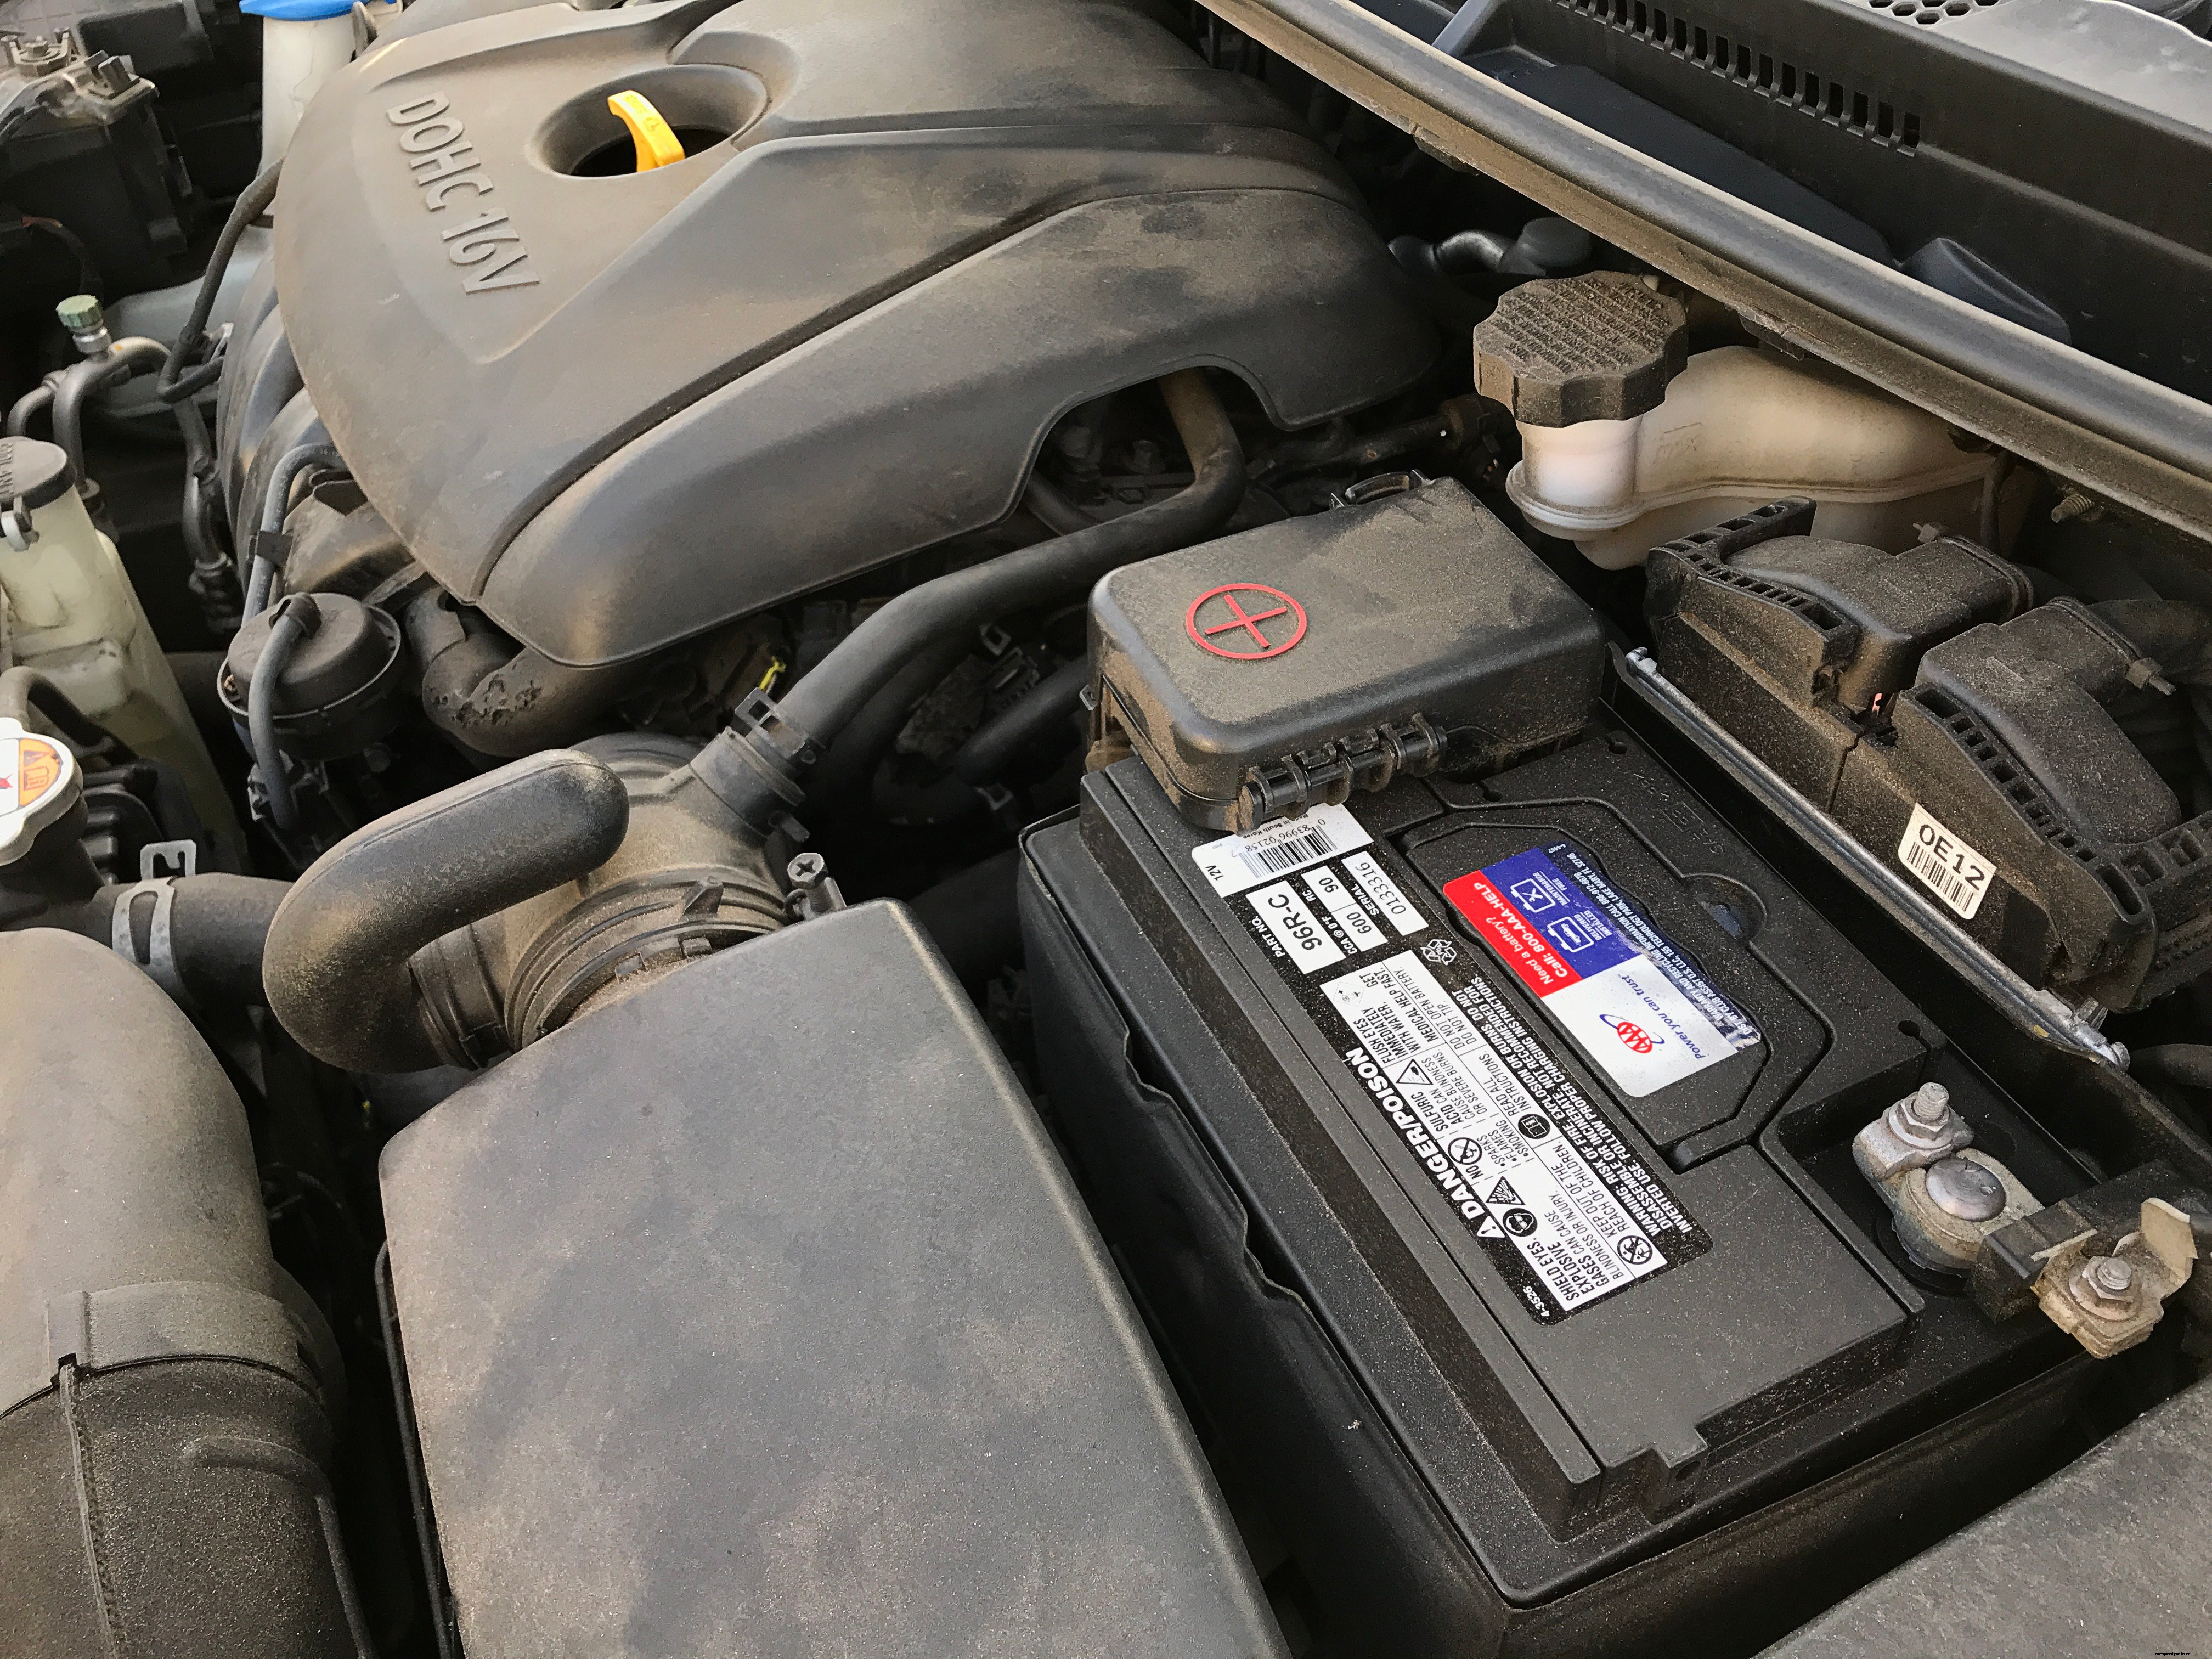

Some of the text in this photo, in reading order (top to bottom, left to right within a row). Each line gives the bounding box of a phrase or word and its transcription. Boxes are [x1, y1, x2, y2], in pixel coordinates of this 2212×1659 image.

[387, 91, 540, 295] DOHC 16V
[1245, 836, 1277, 852] 02158
[1262, 824, 1283, 832] South
[1279, 824, 1310, 840] 83996
[1205, 865, 1224, 881] 12V
[1566, 852, 1585, 868] 32746
[1580, 866, 1592, 874] FL
[1301, 889, 1317, 902] RC
[1317, 876, 1339, 893] 90
[1354, 861, 1407, 915] 0133316
[1532, 871, 1568, 906] MAINTENANCE
[1551, 877, 1567, 891] FREE
[1586, 871, 1607, 889] MARY,
[1601, 887, 1620, 901] LAKE
[1349, 883, 1380, 916] SERIAL
[1605, 902, 1622, 917] CALL
[1614, 899, 1634, 916] PARK,
[1250, 915, 1286, 957] PART NO.
[1266, 893, 1323, 951] 96R-C
[1345, 911, 1373, 934] 600
[1472, 881, 1568, 978] Call: 800-AAA-HELP
[1485, 915, 1525, 952] battery?
[1573, 913, 1602, 941] DELIVERED
[1583, 909, 1612, 936] INSTALLED
[1617, 915, 1656, 951] INFORMATION
[1628, 913, 1665, 948] TECHNOLOGY
[1339, 937, 1358, 955] CCA
[1660, 945, 1675, 957] 155
[1670, 954, 1688, 969] LLC,
[1525, 958, 1554, 985] Need
[1650, 948, 1684, 979] RECYCLING
[1681, 966, 1697, 979] U.S.
[1358, 972, 1379, 988] GET
[1678, 977, 1695, 990] AND
[1691, 977, 1716, 999] ASSIST
[1372, 967, 1438, 1042] MEDICAL HELP FAST.
[1392, 967, 1465, 1049] DO NOT OPEN BATTERY.
[1642, 996, 1660, 1012] can
[1689, 988, 1724, 1021] WARRANTY
[1710, 996, 1730, 1013] CLUB
[1724, 1011, 1739, 1022] BY
[1361, 1006, 1409, 1058] IMMEDIATELY
[1375, 1001, 1421, 1053] WITH WATER.
[1436, 1002, 1477, 1045] DO NOT TIP.
[1657, 1011, 1681, 1030] you
[1352, 1017, 1396, 1064] FLUSH EYES
[1615, 1022, 1649, 1053] AAA
[1674, 1030, 1706, 1060] Power
[1420, 1056, 1476, 1120] CAUSE BLINDNESS
[1430, 1050, 1488, 1115] OR SEVERE BURNS.
[1477, 1051, 1532, 1111] INSTRUCTIONS.
[1482, 1076, 1520, 1116] READ ALL
[1410, 1091, 1449, 1132] SULFURIC
[1429, 1087, 1464, 1125] ACID CAN
[1451, 989, 1662, 1236] WARNING: RISK OF FIRE, EXPLOSION OR BURNS. DO NOT
[1463, 985, 1674, 1229] DISASSEMBLE OR INCINERATE. NOT RECOMMENDED FOR
[1469, 973, 1693, 1233] INVERTED USE. FOLLOW PROPER CHARGING INSTRUCTIONS.
[1345, 1046, 1486, 1220] DANGER/POISON
[1465, 1164, 1483, 1180] NO
[1550, 1141, 1630, 1232] REACH OF CHILDREN.
[1550, 1162, 1617, 1238] KEEP OUT OF THE
[1543, 1209, 1610, 1287] GASES CAN CAUSE
[1547, 1192, 1624, 1280] BLINDNESS OR INJURY.
[1525, 1237, 1580, 1301] SHIELD EYES.
[1546, 1241, 1595, 1294] EXPLOSIVE
[1522, 1285, 1550, 1317] 4-3526
